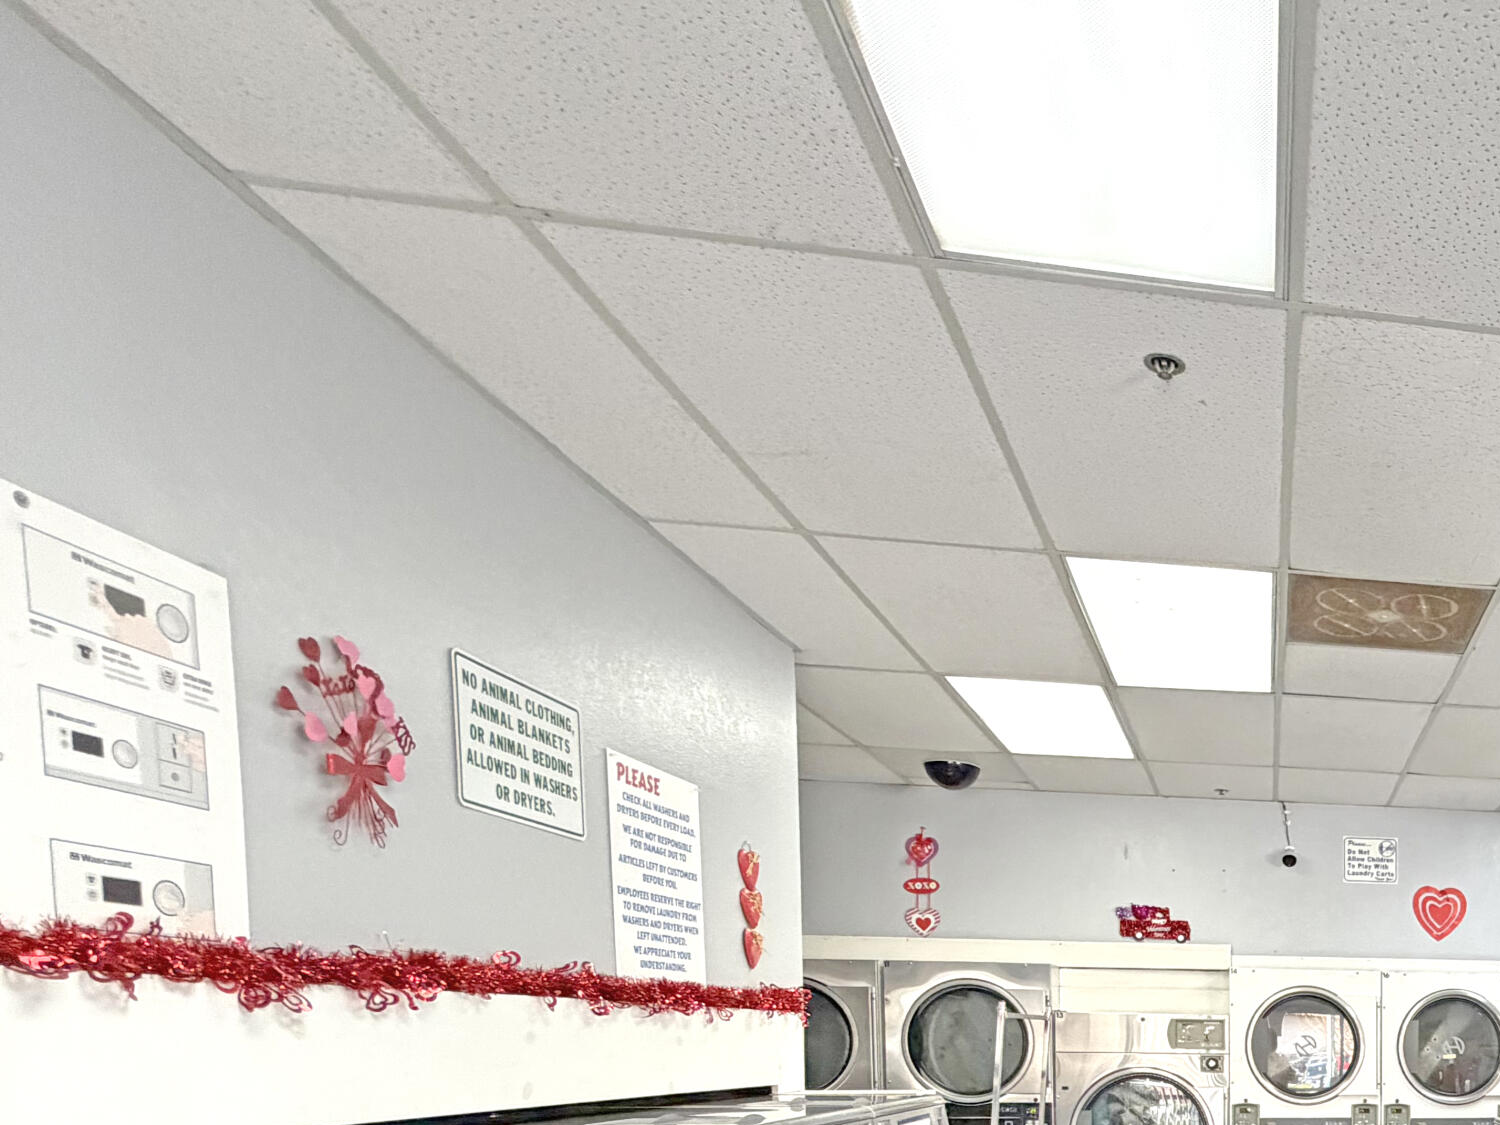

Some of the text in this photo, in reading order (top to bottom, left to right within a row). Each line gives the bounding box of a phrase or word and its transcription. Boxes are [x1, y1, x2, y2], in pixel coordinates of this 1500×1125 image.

[461, 667, 575, 736] NO ANIMAL CLOTHING,
[470, 698, 571, 754] ANIMAL BLANKETS
[469, 722, 573, 778] OR ANIMAL BEDDING
[466, 747, 578, 802] ALLOWED IN WASHERS
[616, 761, 660, 797] PLEASE
[495, 782, 556, 817] OR DRYERS.
[622, 791, 690, 823] CHECK ALL WASHERS AND
[616, 803, 639, 819] DRYERS
[640, 811, 662, 827] BEFORE
[663, 819, 679, 832] EVERY
[622, 823, 692, 853] WE ARE NOT RESPONSIBLE
[630, 838, 687, 862] FOR DAMAGE DUE TO
[618, 853, 698, 882] ARTICLES LEFT BY CUSTOMERS
[642, 873, 664, 887] BEFORE
[617, 885, 701, 911] EMPLOYEES RESERVE THE RIGHT
[623, 900, 697, 923] TO REMOVE LAUNDRY FROM
[622, 914, 699, 935] WASHERS AND DRYERS WHEN
[637, 930, 650, 941] LEFT
[633, 945, 692, 961] WE APPRECIATE YOUR
